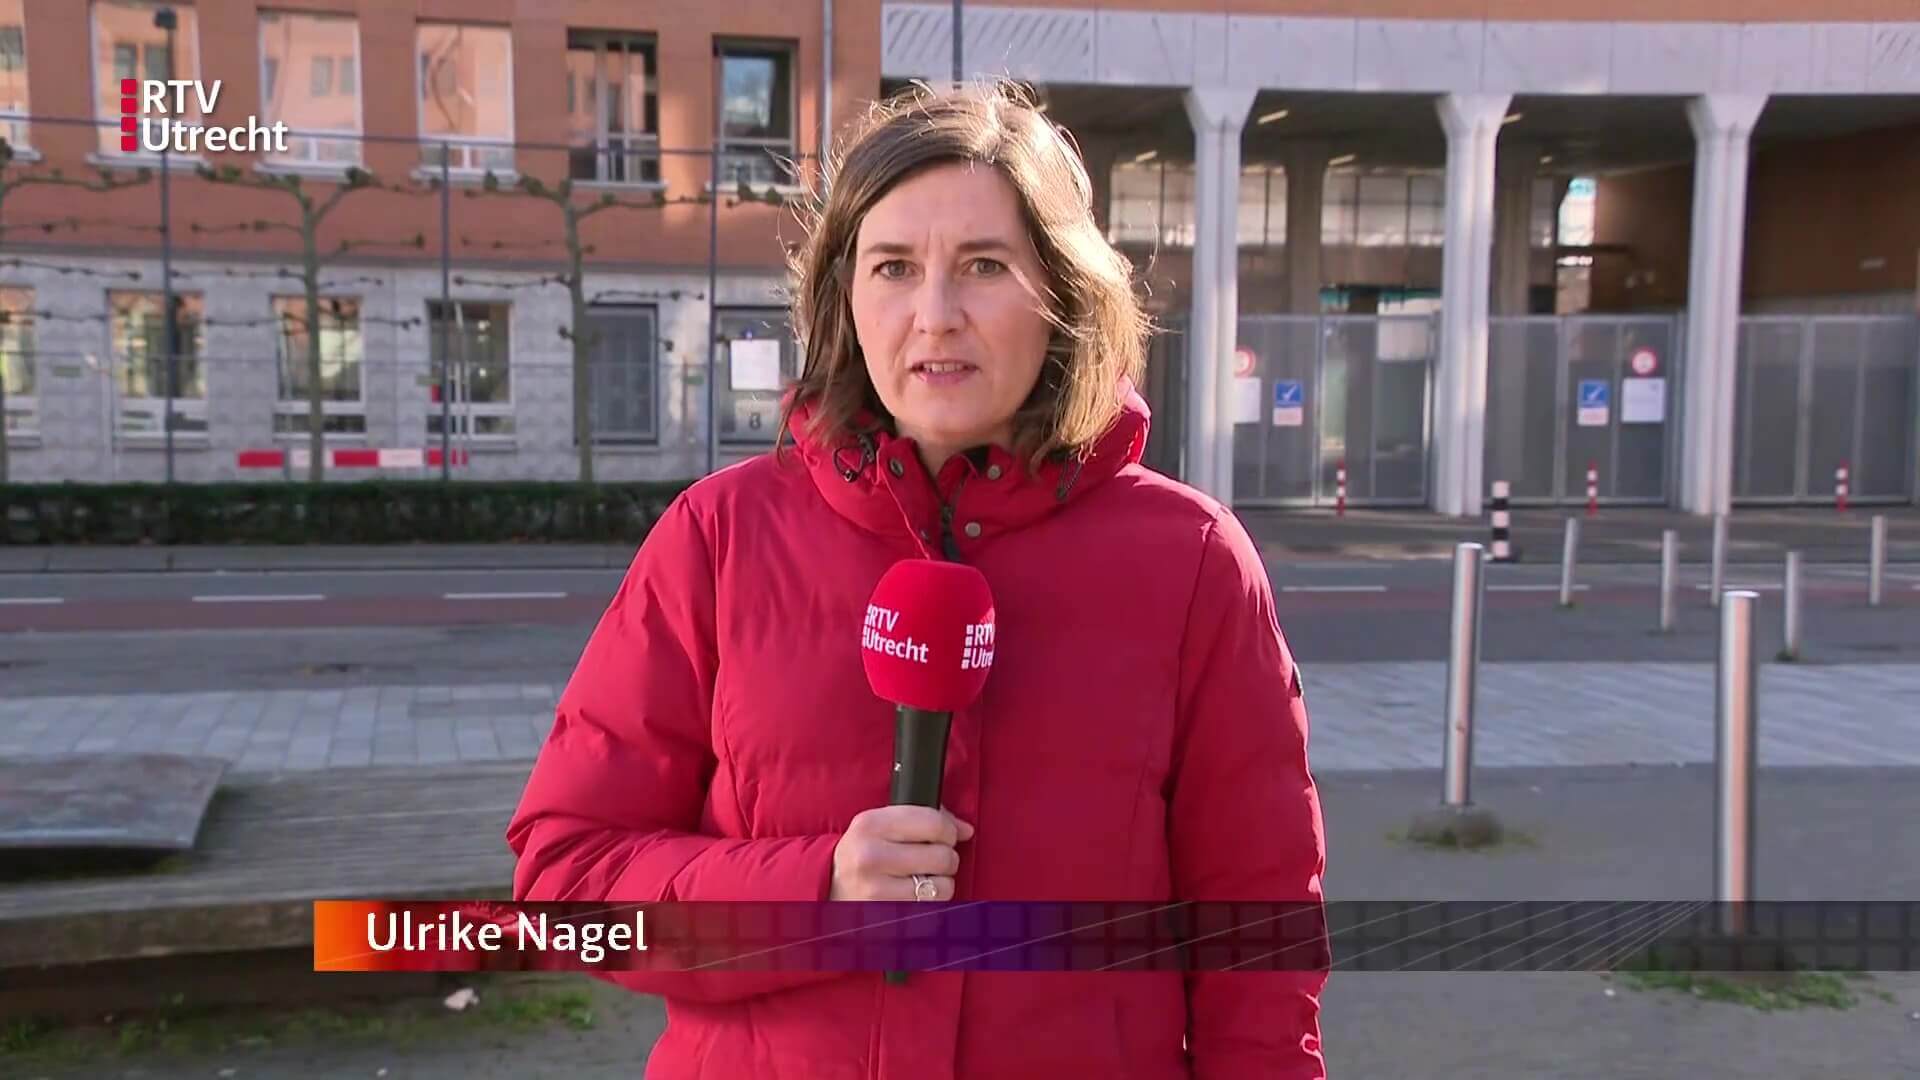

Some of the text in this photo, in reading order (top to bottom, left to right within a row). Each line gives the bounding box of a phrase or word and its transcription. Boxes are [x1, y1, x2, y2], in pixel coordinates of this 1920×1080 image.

[869, 605, 899, 632] RTV
[866, 627, 929, 664] Utrecht
[971, 647, 993, 669] Utre
